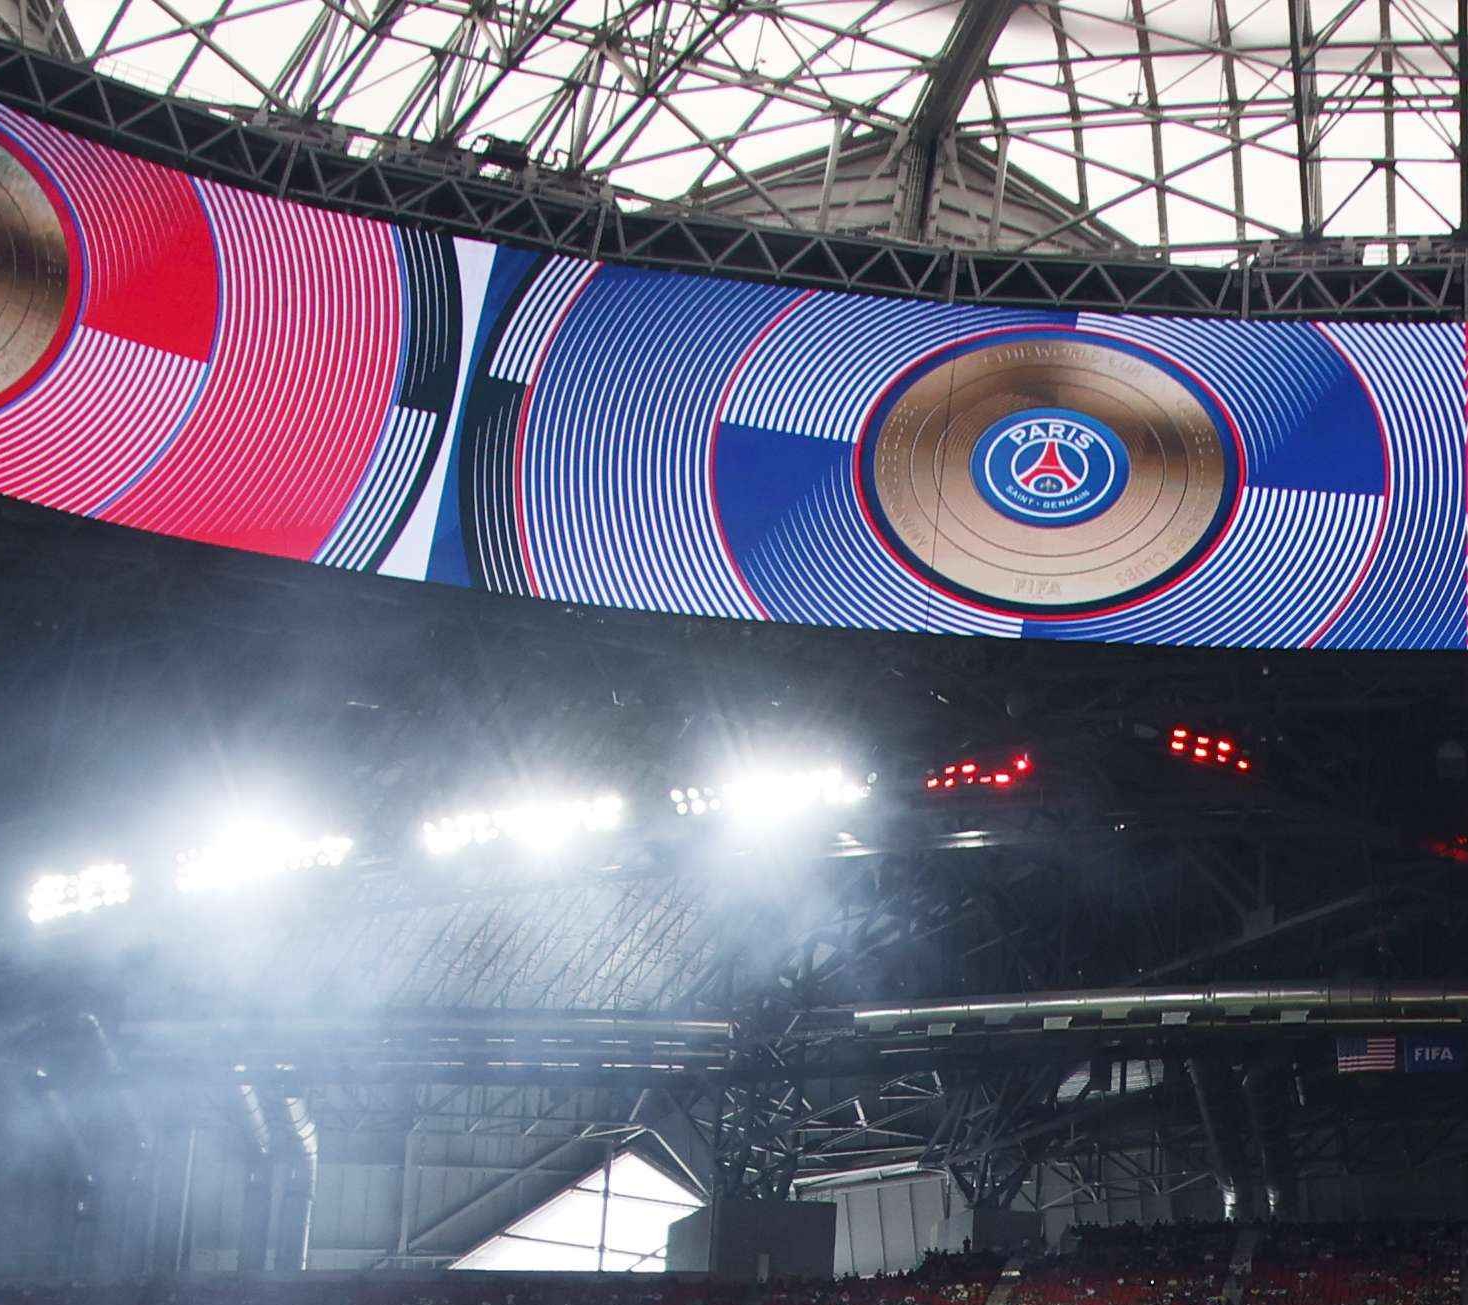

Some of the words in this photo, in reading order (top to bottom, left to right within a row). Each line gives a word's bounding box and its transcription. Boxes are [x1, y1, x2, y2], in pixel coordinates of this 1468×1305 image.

[1009, 423, 1094, 451] PARIS
[1005, 486, 1033, 507] SAINT
[1042, 489, 1091, 510] GERMAIN
[1413, 1046, 1453, 1062] FIFA
